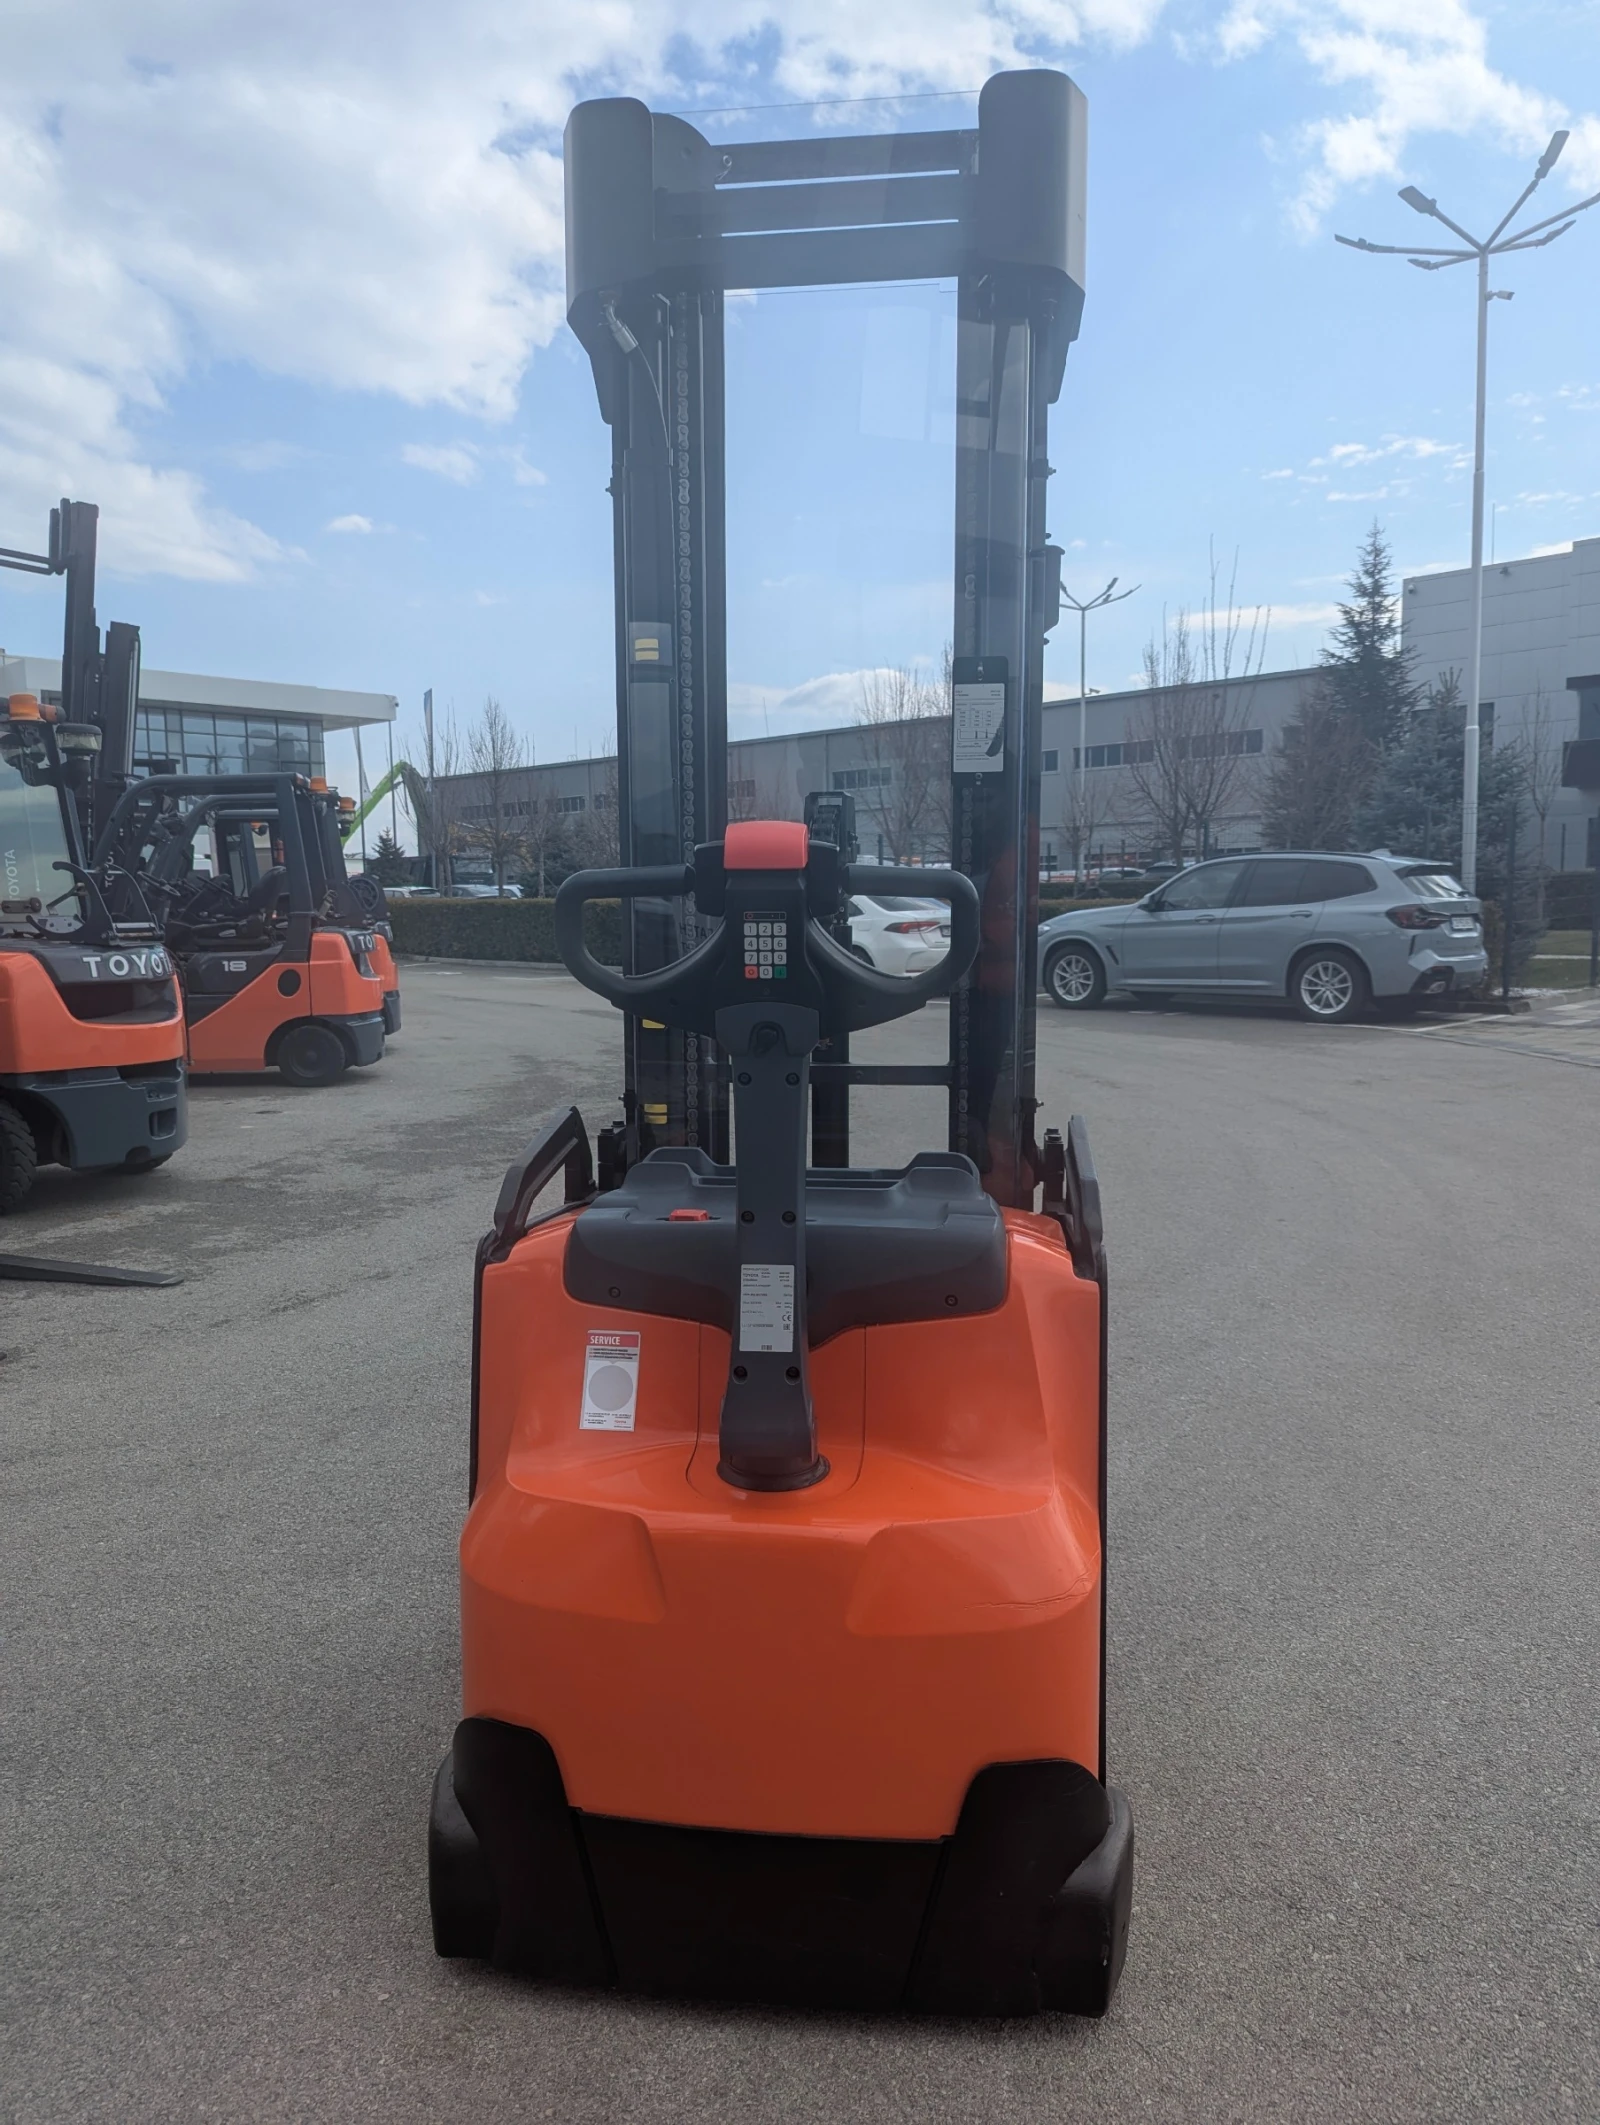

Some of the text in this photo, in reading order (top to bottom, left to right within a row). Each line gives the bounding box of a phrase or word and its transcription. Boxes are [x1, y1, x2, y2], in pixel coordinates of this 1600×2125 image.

[762, 925, 768, 934] 2
[777, 925, 783, 934] 3
[747, 940, 783, 948] 4 5 6
[748, 954, 783, 962] 7 8 9
[222, 960, 247, 972] 18
[590, 1335, 621, 1345] SERVICE
